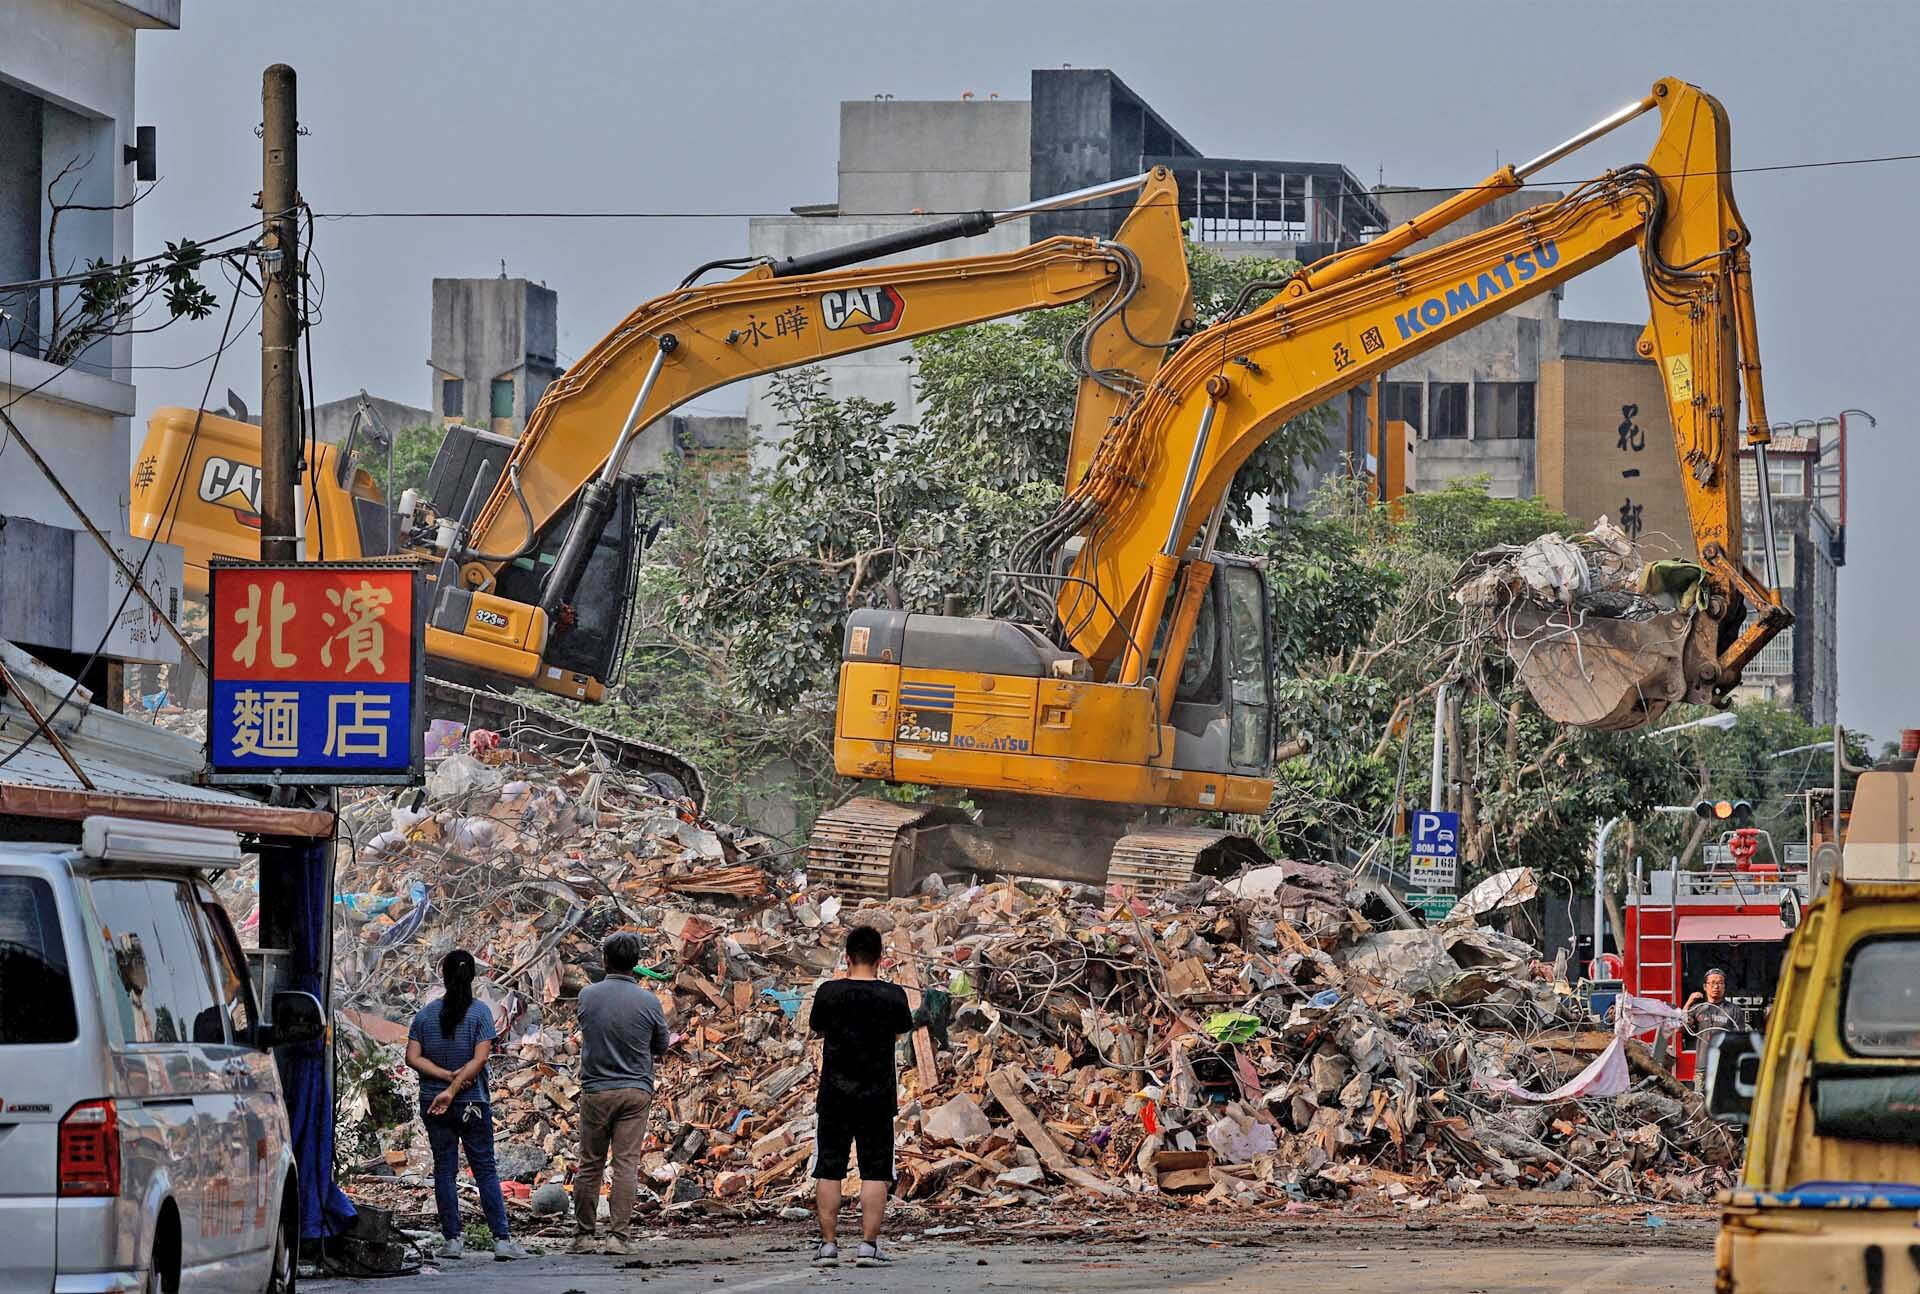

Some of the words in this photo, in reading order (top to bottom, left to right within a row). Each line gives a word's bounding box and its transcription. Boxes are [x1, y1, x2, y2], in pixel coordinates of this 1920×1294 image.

[821, 286, 882, 330] CAT
[1395, 240, 1560, 340] KOMATSU
[232, 580, 392, 675] 北濱
[232, 689, 391, 758] 麵店
[1418, 814, 1440, 841] P
